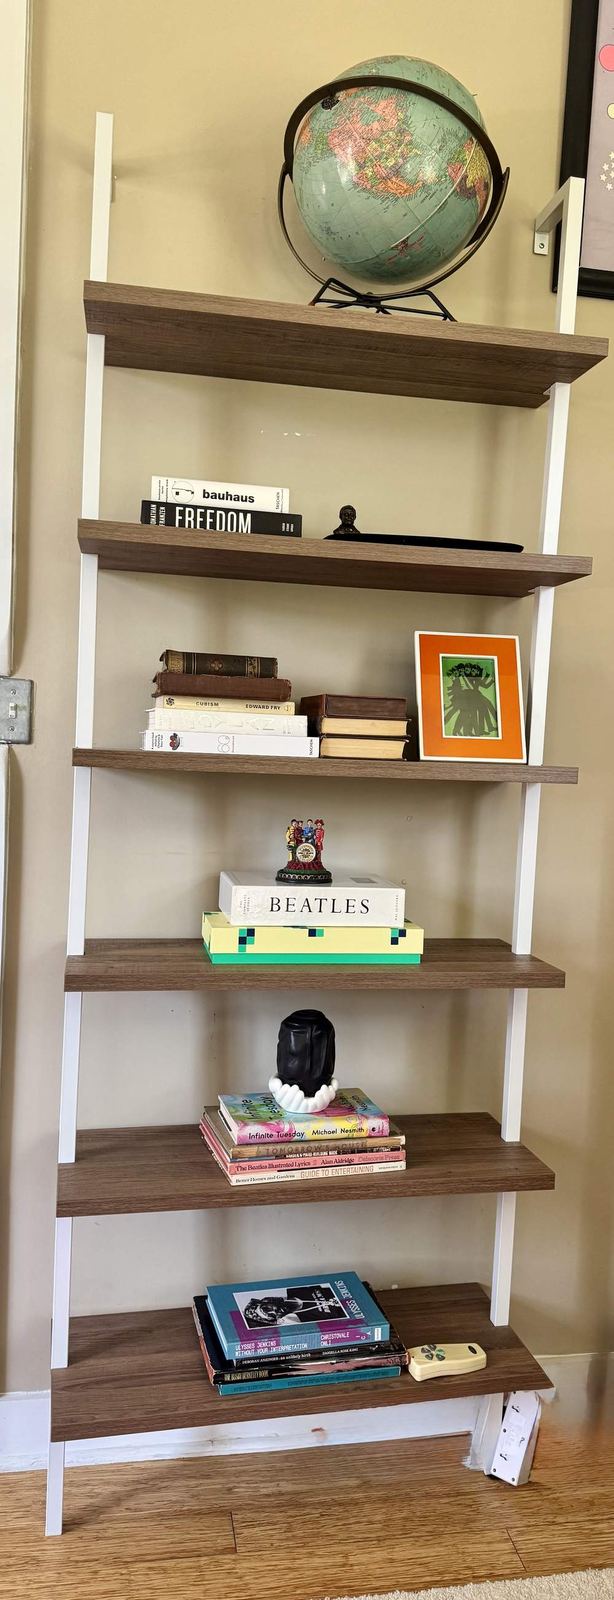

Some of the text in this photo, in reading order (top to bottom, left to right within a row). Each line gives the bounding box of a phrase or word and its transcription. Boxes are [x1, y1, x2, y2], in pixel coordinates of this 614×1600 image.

[202, 488, 255, 504] bauhaus
[175, 506, 252, 534] FREEDOM
[270, 896, 370, 914] BEATLES
[300, 1170, 320, 1178] GUIDE
[332, 1165, 374, 1175] ENTERTAINING
[235, 1342, 255, 1351] ULYSSES
[270, 1343, 308, 1353] INTERPRETATION
